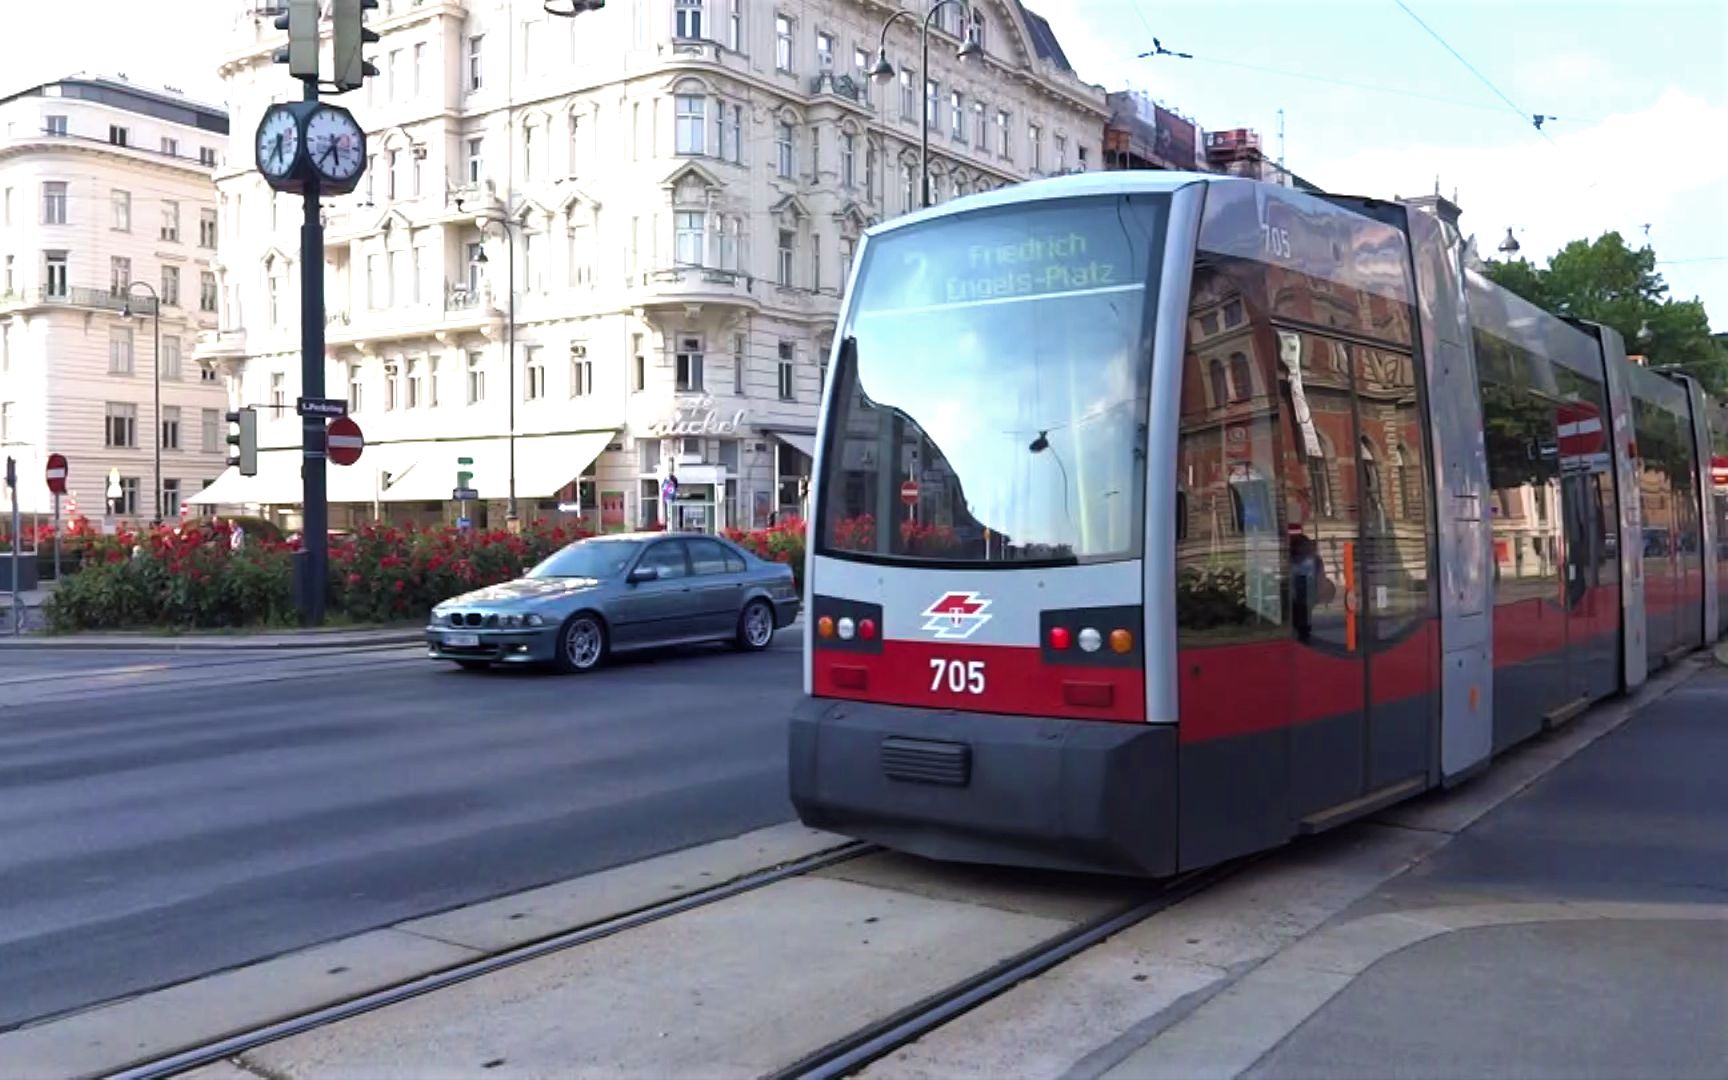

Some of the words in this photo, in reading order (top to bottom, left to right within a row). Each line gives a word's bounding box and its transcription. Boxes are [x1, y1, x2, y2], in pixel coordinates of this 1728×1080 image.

[968, 231, 1088, 269] Friedrich
[1260, 223, 1292, 259] 705
[945, 260, 1115, 302] Engels-Platz
[929, 658, 986, 695] 705
